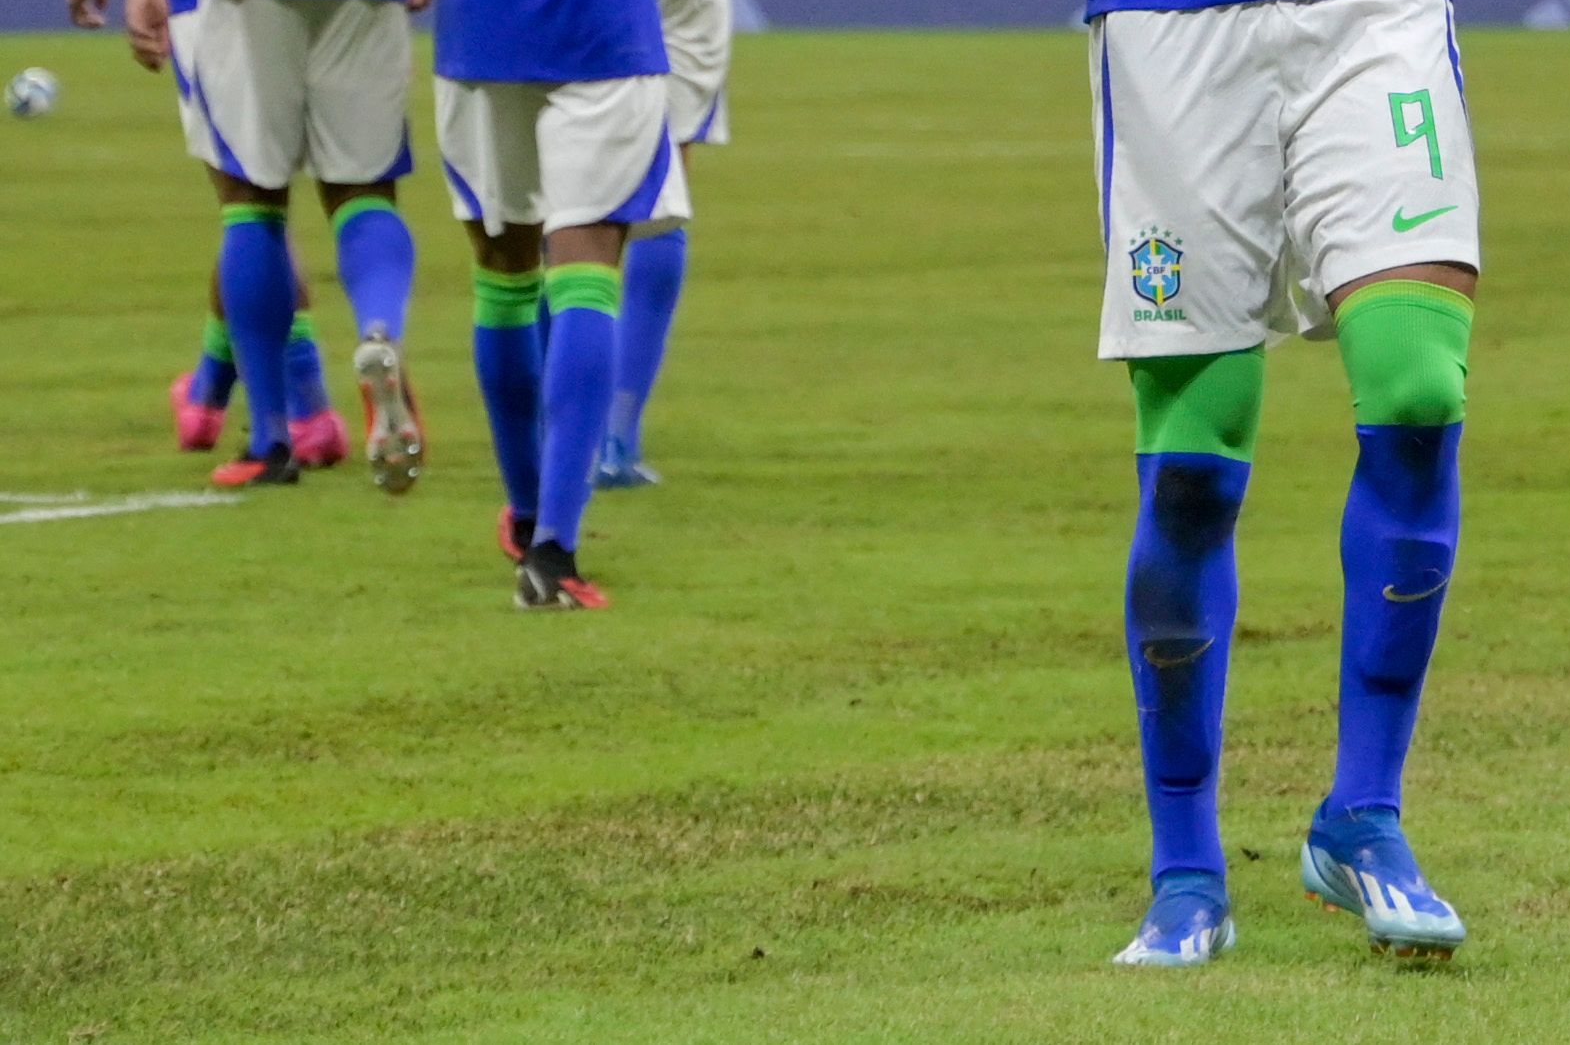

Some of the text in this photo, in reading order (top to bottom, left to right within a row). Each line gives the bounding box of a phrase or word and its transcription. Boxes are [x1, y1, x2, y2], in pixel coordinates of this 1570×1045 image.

[1388, 88, 1443, 181] 9
[1146, 266, 1166, 275] CBF
[1133, 309, 1187, 322] BRASIL
